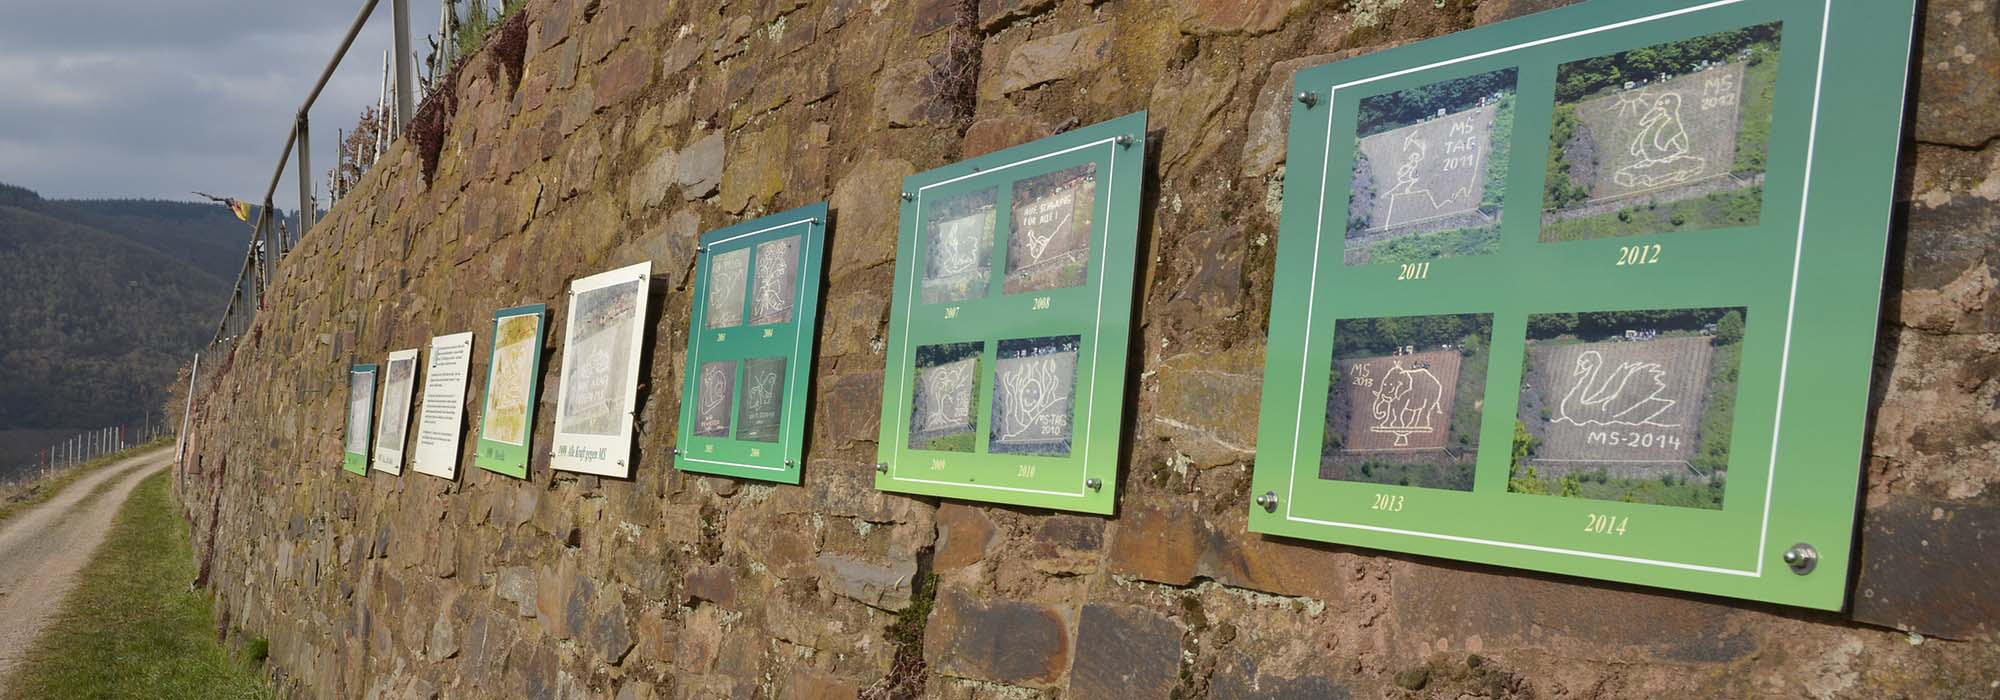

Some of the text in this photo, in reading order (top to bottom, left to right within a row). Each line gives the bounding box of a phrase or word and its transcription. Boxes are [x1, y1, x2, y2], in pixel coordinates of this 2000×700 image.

[1616, 244, 1662, 266] 2012
[1398, 262, 1430, 281] 2011
[1350, 363, 1371, 378] MS
[1587, 431, 1681, 451] MS-2014
[1017, 464, 1036, 478] 2010
[1372, 494, 1405, 512] 2013
[1584, 513, 1630, 536] 2014
